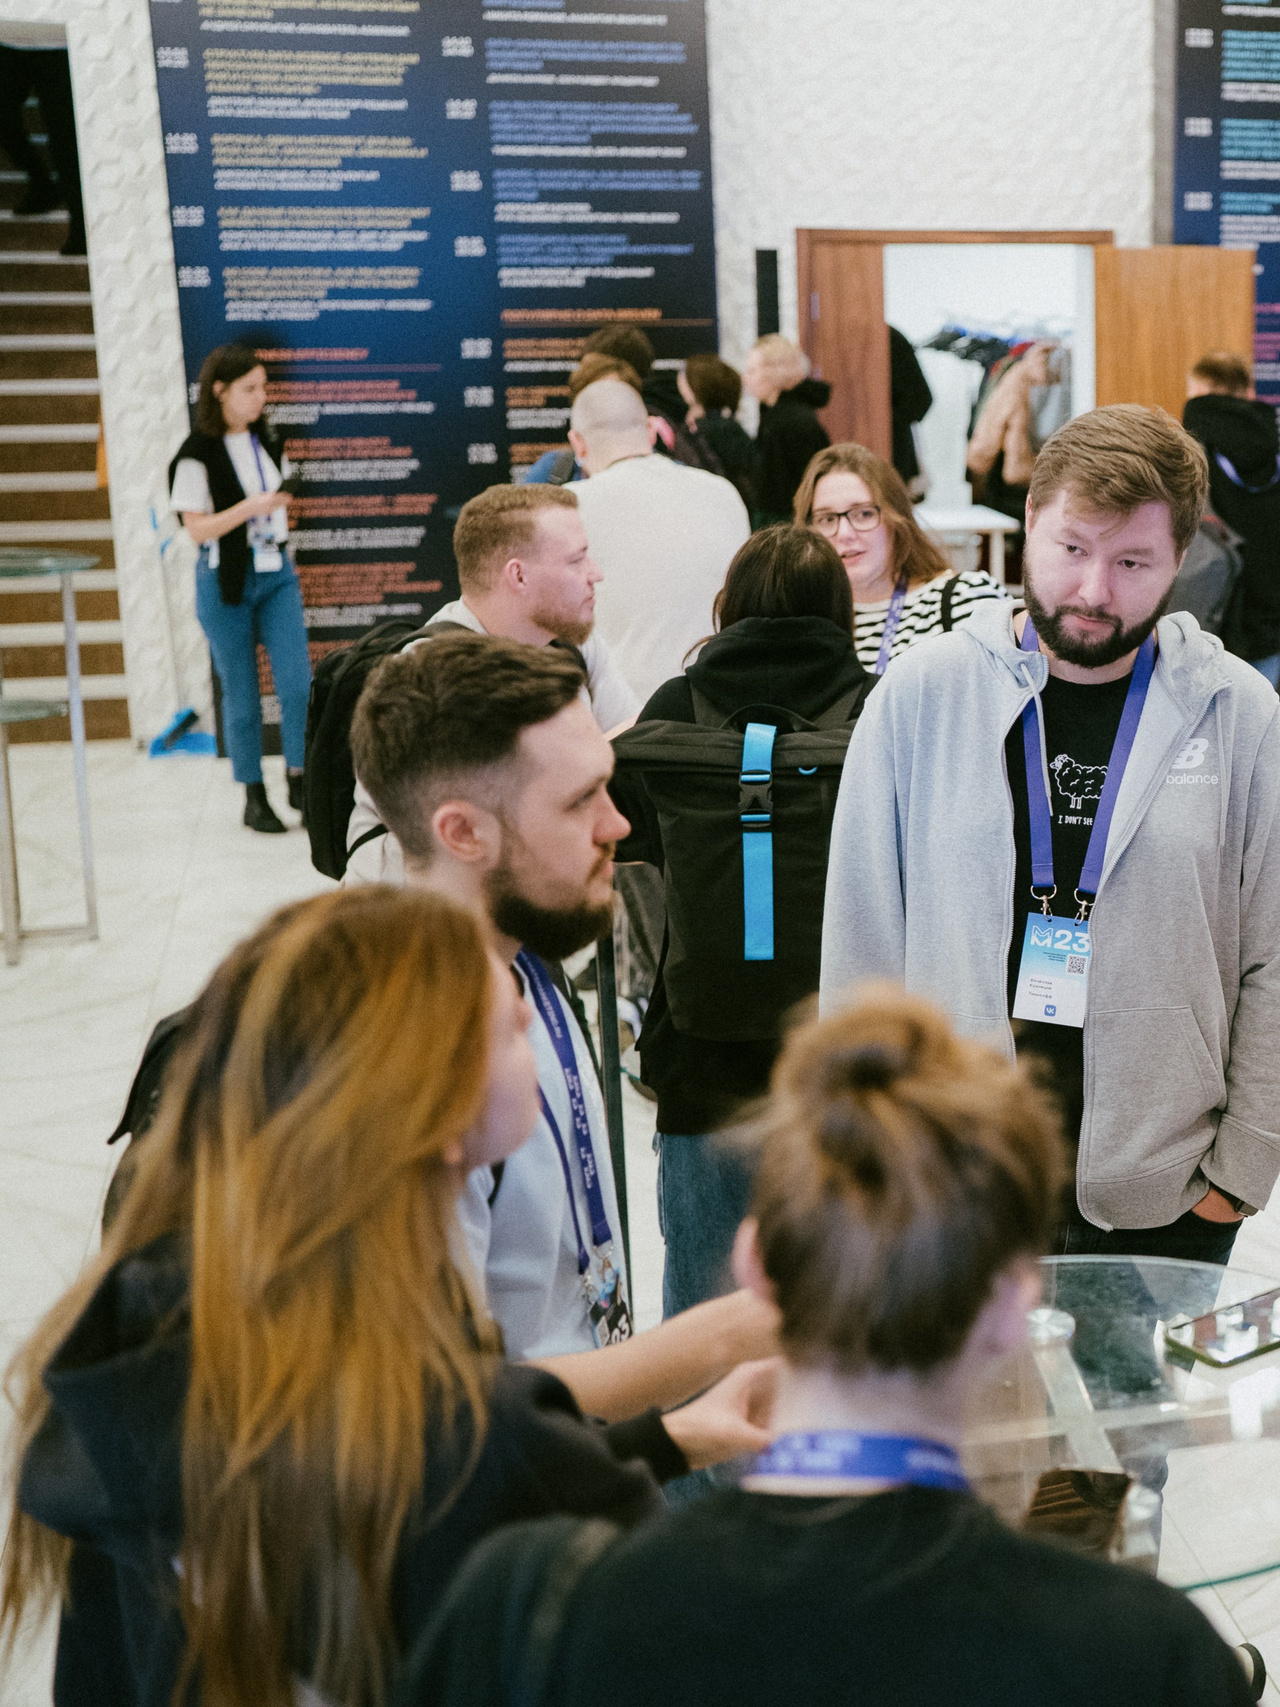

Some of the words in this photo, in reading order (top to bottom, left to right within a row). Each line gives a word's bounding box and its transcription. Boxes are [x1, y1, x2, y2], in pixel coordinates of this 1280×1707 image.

[1058, 815, 1063, 824] I
[1064, 816, 1082, 825] DON'T
[1083, 816, 1093, 826] SEE
